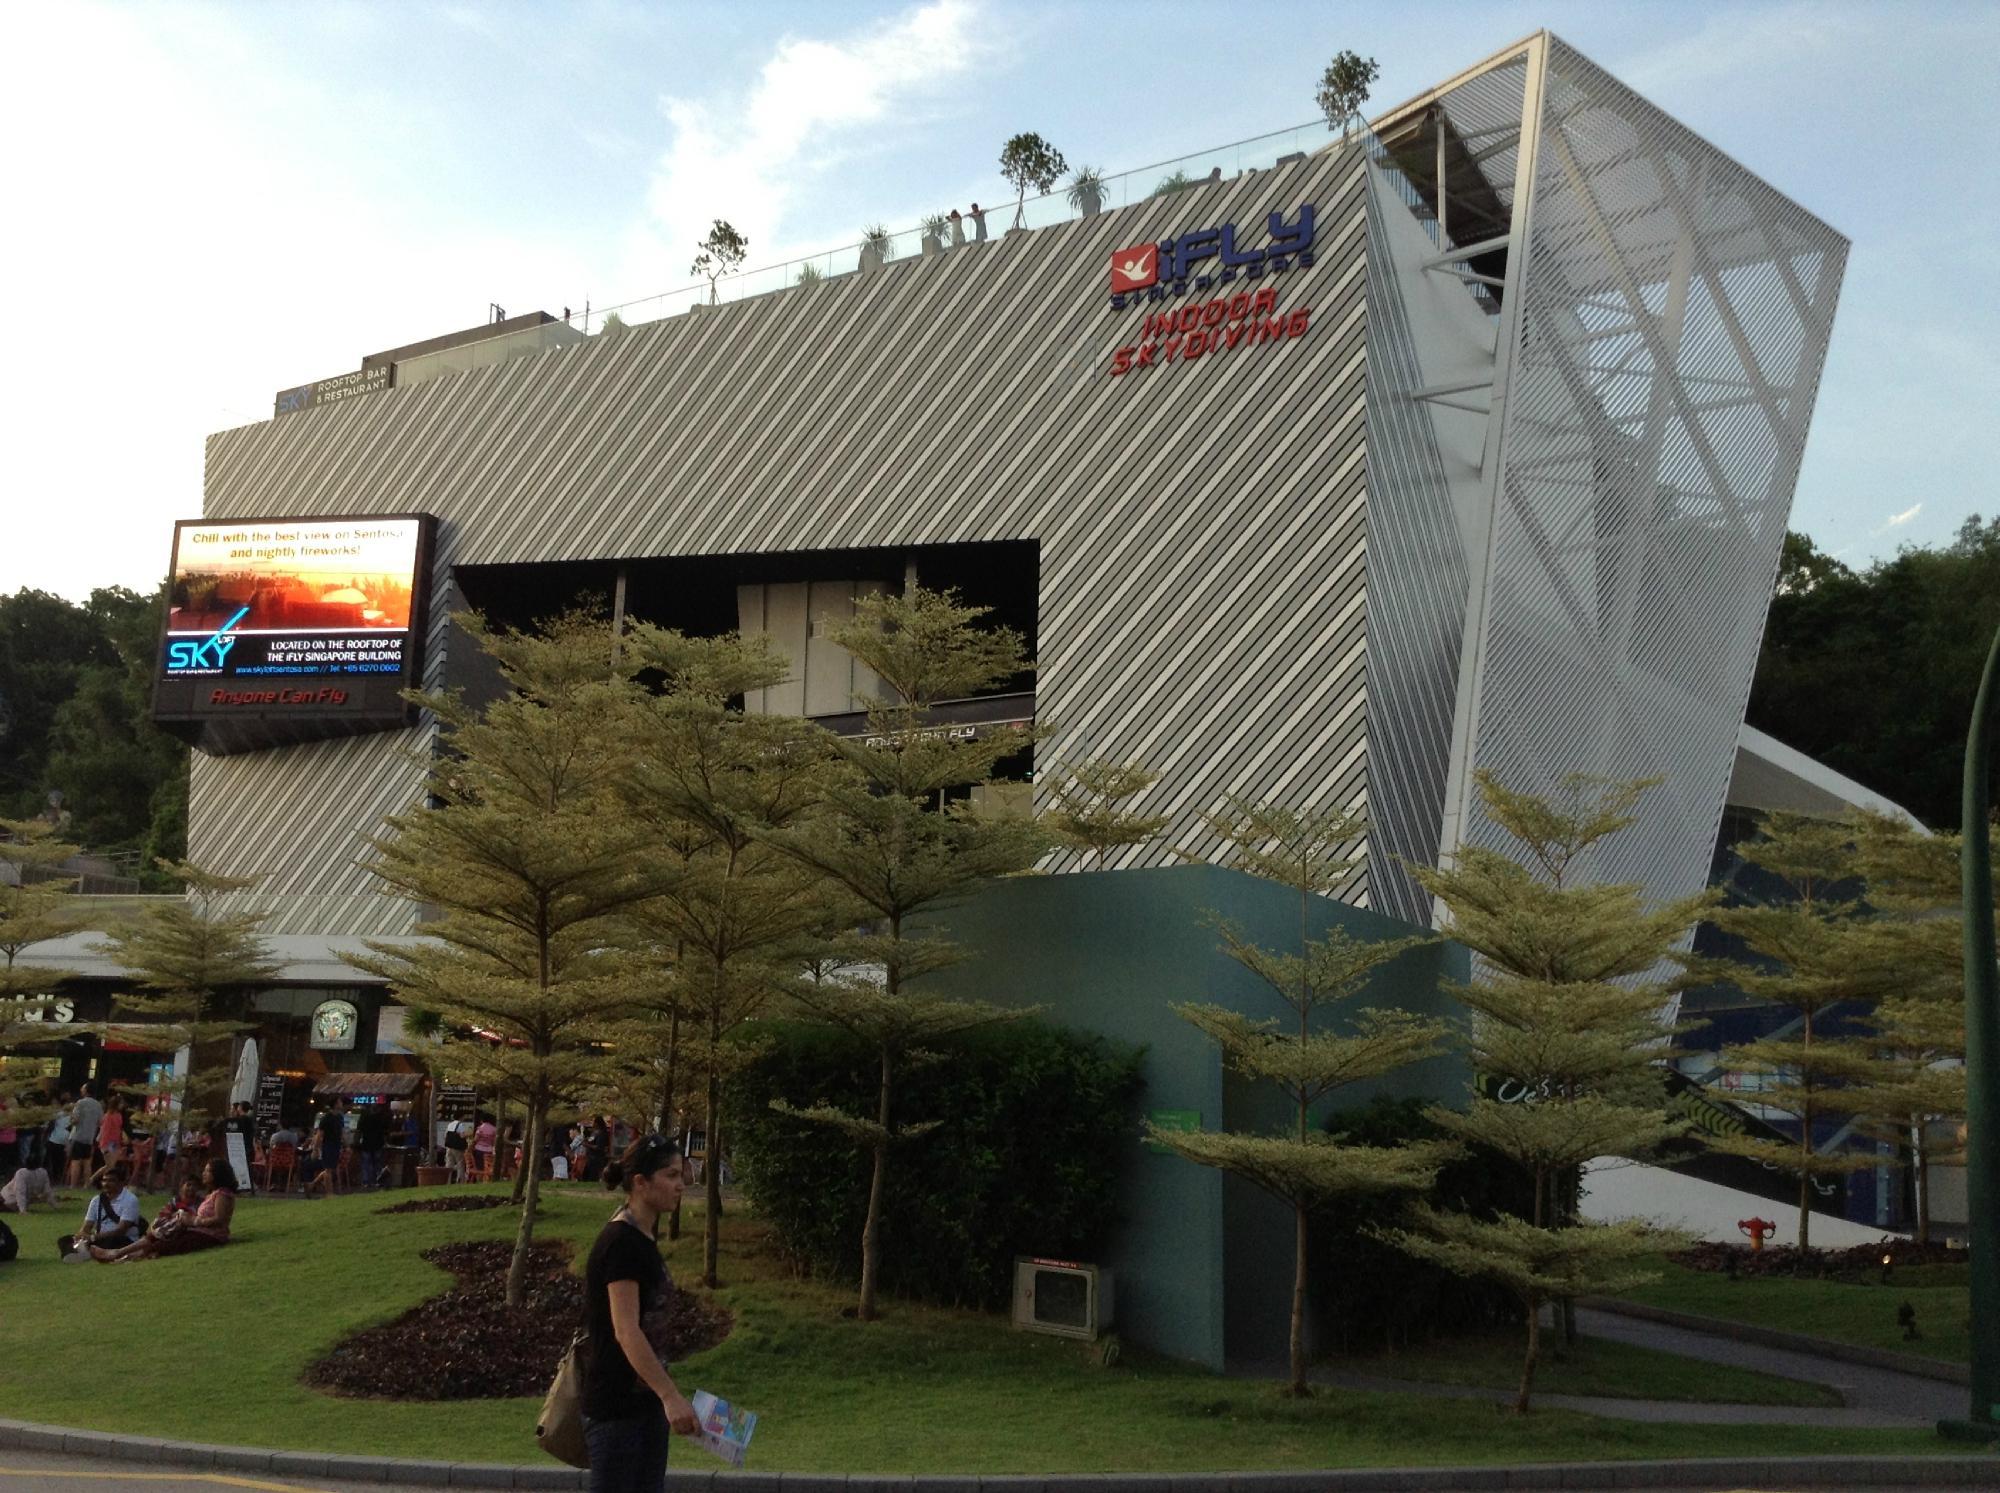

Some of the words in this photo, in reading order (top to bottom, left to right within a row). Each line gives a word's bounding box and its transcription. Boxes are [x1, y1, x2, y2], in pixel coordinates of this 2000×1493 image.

[1159, 202, 1317, 282] iFLY
[1110, 252, 1314, 311] SINGAPORE
[1141, 287, 1277, 339] INDOOR
[1110, 308, 1311, 376] SKYDIVING
[318, 373, 363, 393] ROOFTOP
[367, 367, 387, 380] BAR
[324, 379, 386, 403] RESTAURANT
[192, 533, 219, 544] Chill
[223, 532, 248, 543] with
[252, 532, 271, 542] the
[275, 531, 300, 541] best
[304, 531, 330, 541] view
[336, 531, 350, 540] on
[230, 547, 253, 558] and
[256, 545, 296, 559] nightly
[271, 641, 310, 651] LOCATED
[312, 641, 326, 650] ON
[328, 640, 345, 650] THE
[346, 639, 389, 649] ROOFTOP
[390, 638, 403, 649] OF
[267, 652, 284, 662] THE
[286, 652, 304, 662] iFLY
[305, 651, 356, 662] SINGAPORE
[358, 650, 402, 661] BUILDING
[210, 688, 275, 705] Anyone
[279, 688, 314, 704] Can
[317, 687, 347, 704] Fly
[949, 727, 975, 738] FLY
